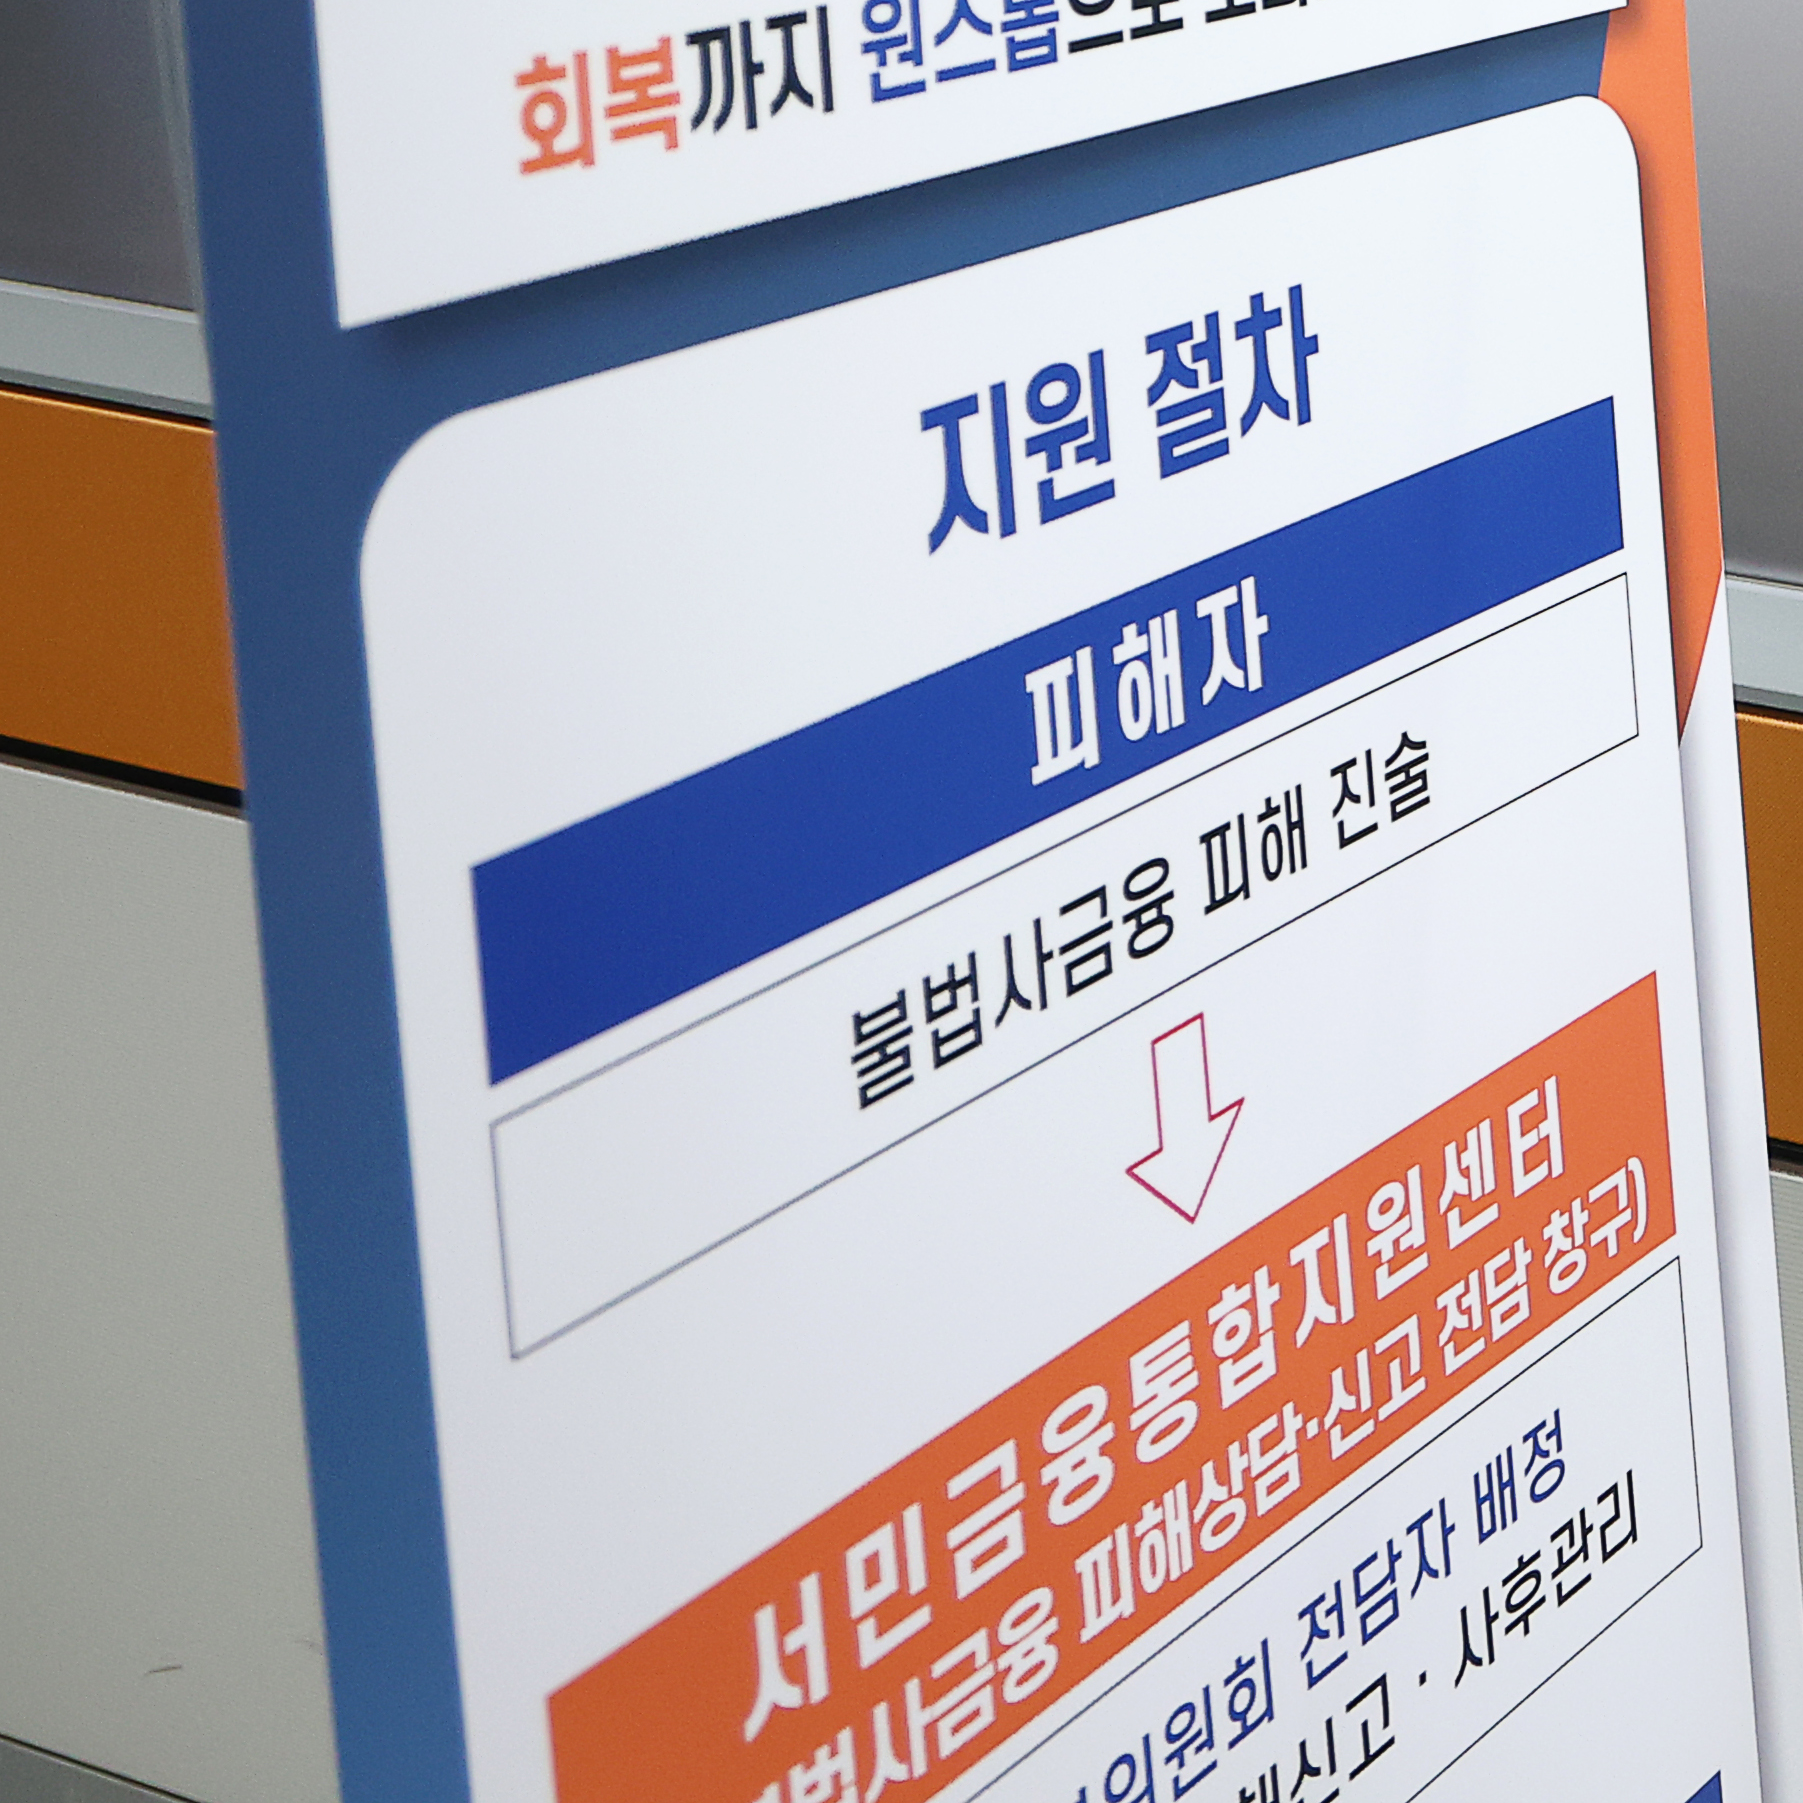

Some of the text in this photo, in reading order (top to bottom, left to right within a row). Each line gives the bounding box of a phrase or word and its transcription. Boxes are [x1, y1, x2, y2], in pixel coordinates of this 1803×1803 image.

[515, 4, 835, 174] 회복까지
[920, 284, 1320, 555] 지원 절차
[1024, 575, 1270, 786] 피해자
[851, 731, 1431, 1110] 불법사금융 피해 진술
[743, 1074, 1565, 1744] 서민금융통합지원센터
[752, 1156, 1650, 1803] 법사금융 피해상담·신고 전담 창구)
[1074, 1408, 1566, 1803] 위원회 전담자 배정
[1454, 1468, 1639, 1689] 사후관리
